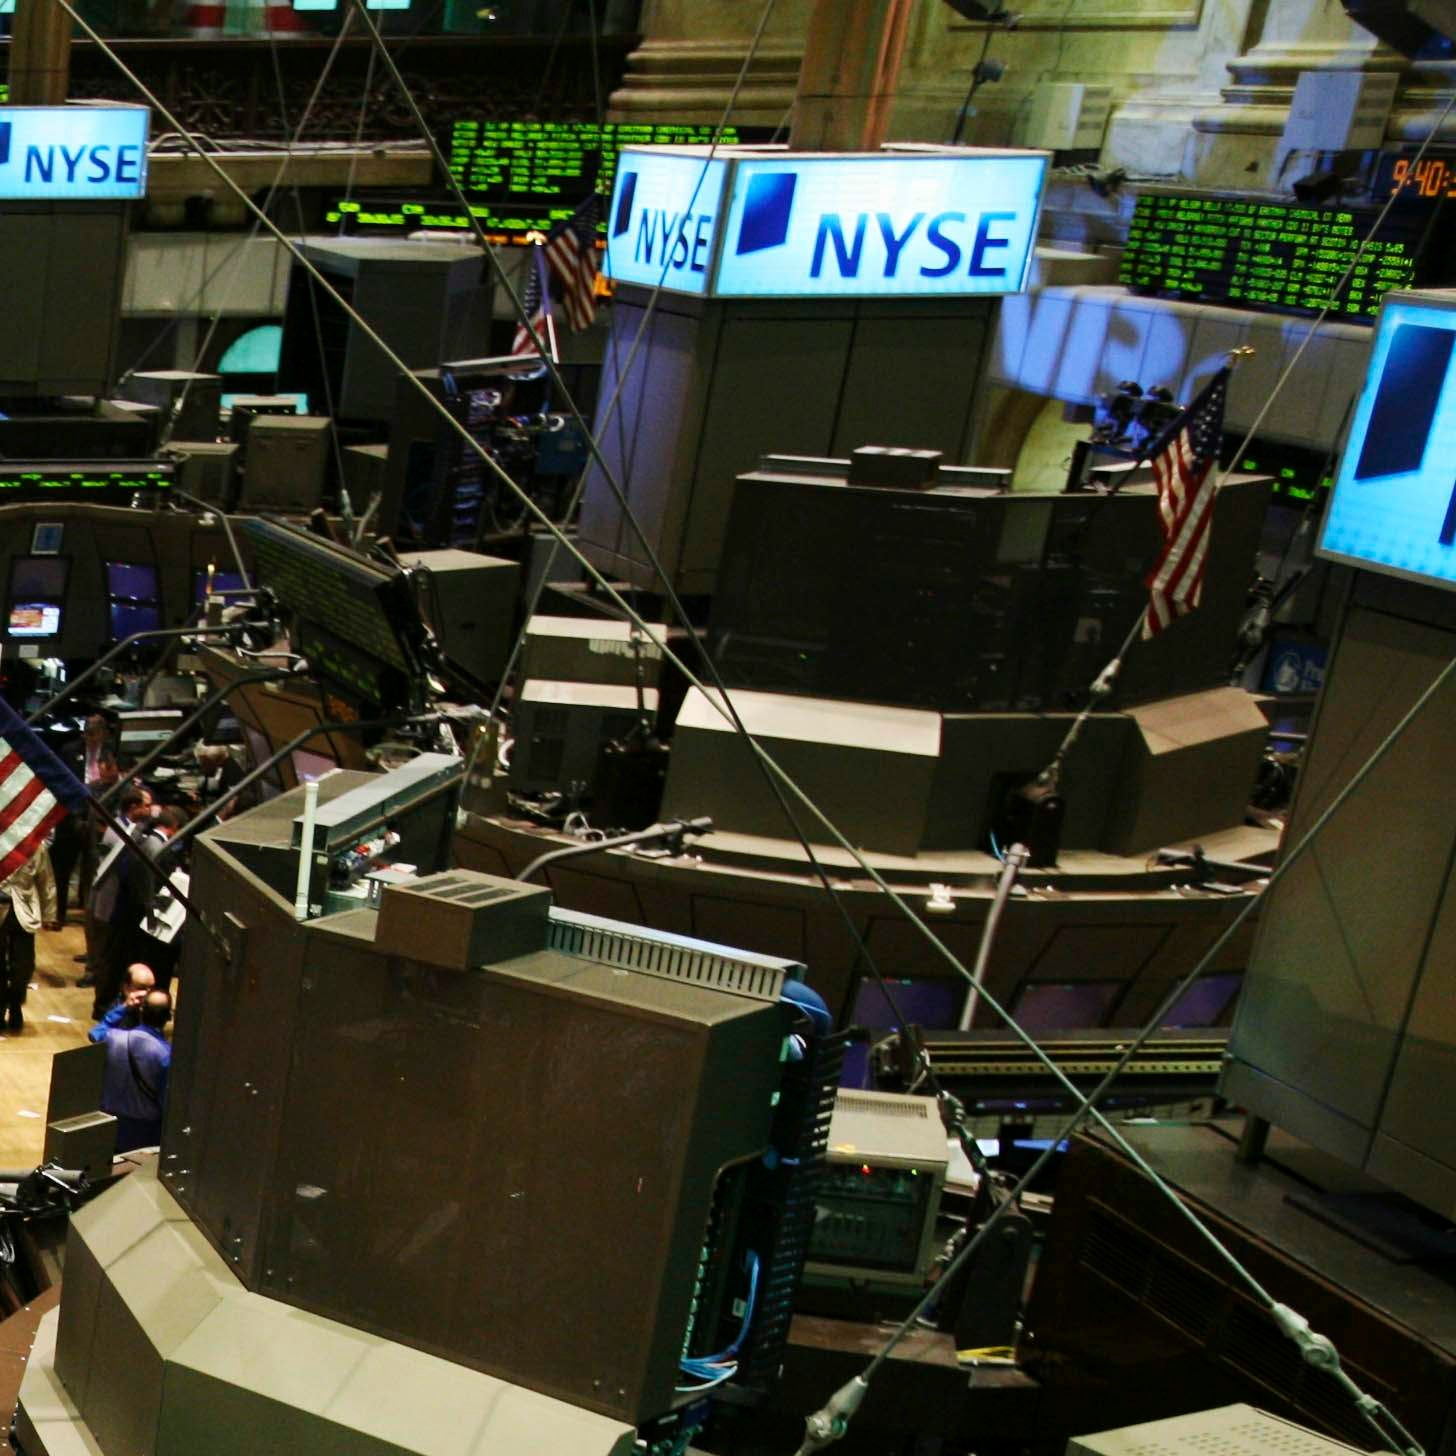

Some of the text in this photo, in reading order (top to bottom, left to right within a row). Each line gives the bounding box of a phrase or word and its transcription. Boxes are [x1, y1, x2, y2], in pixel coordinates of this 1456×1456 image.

[24, 144, 139, 184] NYSE
[635, 207, 711, 272] NYSE
[810, 212, 1017, 279] NYSE
